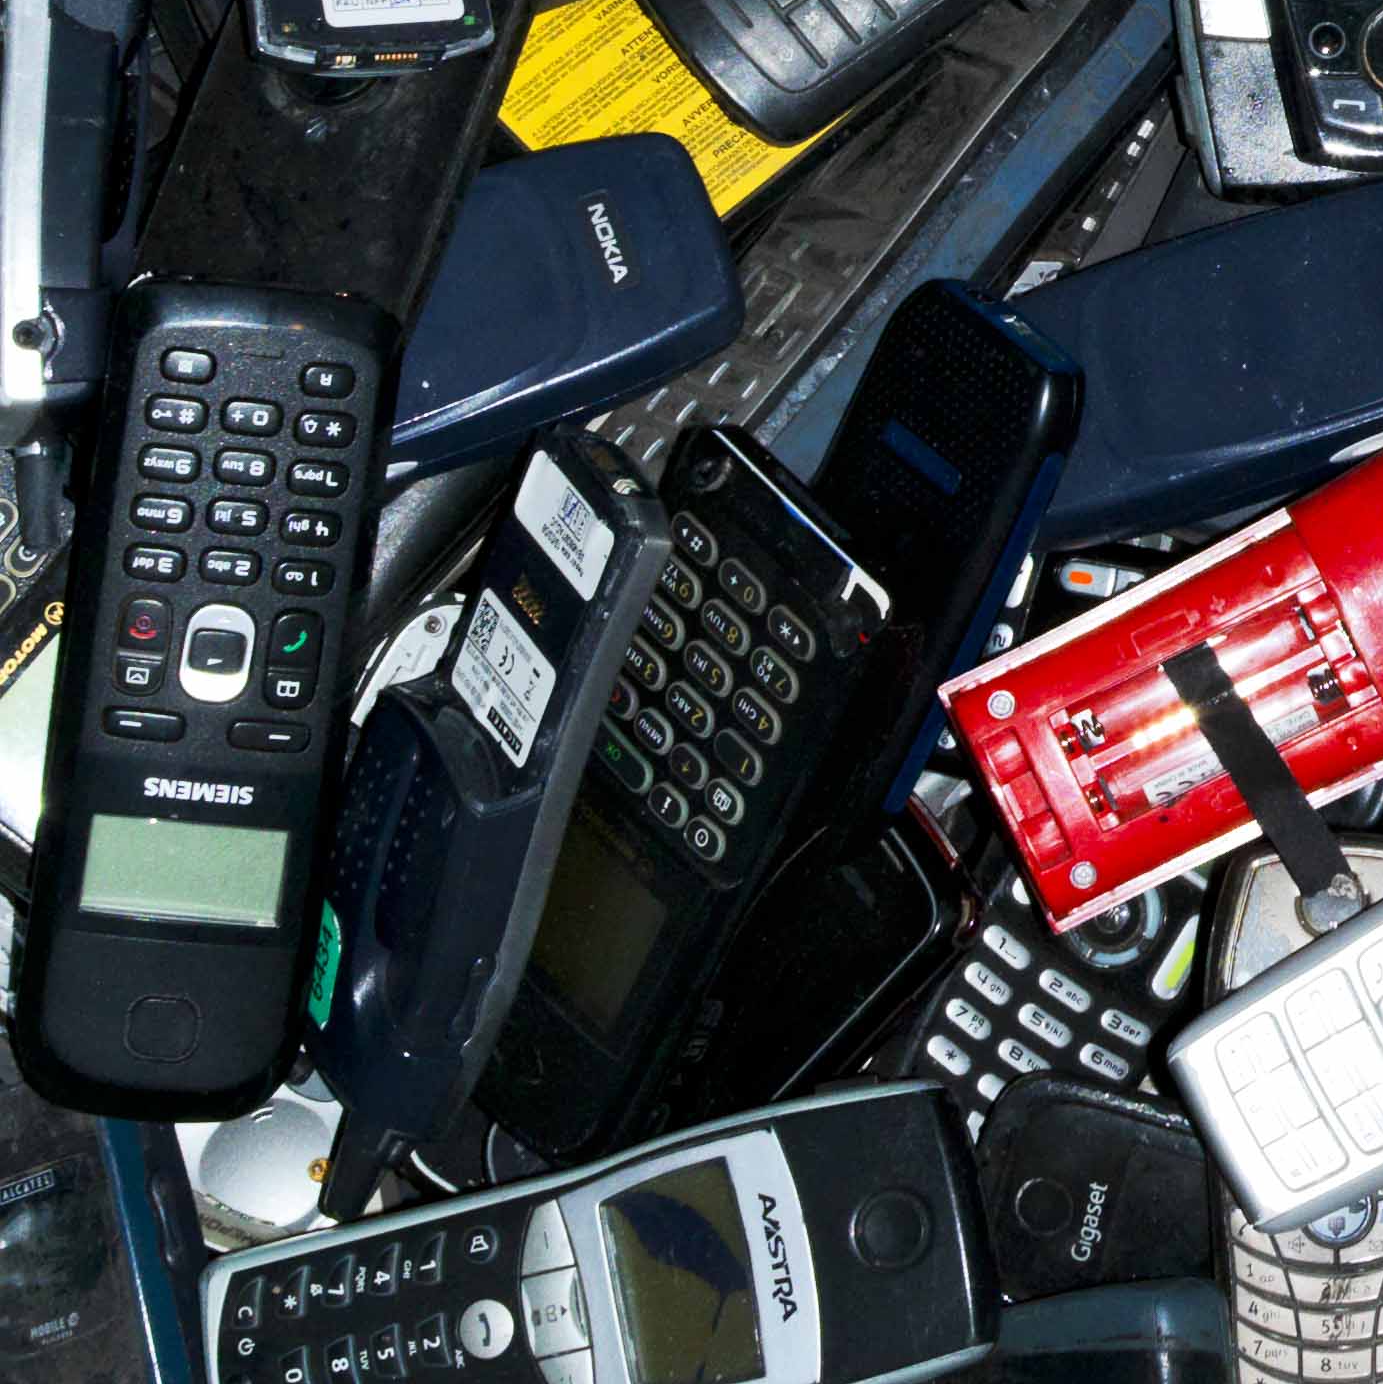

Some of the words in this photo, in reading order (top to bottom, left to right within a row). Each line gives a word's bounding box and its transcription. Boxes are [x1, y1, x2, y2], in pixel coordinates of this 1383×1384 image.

[618, 23, 661, 57] ATTENT
[650, 57, 686, 86] VORS
[679, 96, 719, 128] AVVER
[710, 127, 751, 159] PRECA
[588, 201, 627, 285] NOKIA
[320, 373, 333, 387] R
[142, 776, 255, 806] SIEMENS
[1, 1171, 53, 1201] ALCATEL
[1070, 1179, 1109, 1264] Gigaset
[756, 1192, 798, 1324] AASTRA
[28, 1314, 68, 1340] MOBILE
[331, 1356, 349, 1374] 8
[358, 1349, 371, 1372] TUV
[453, 1349, 466, 1370] ABC
[284, 1368, 302, 1383] 0
